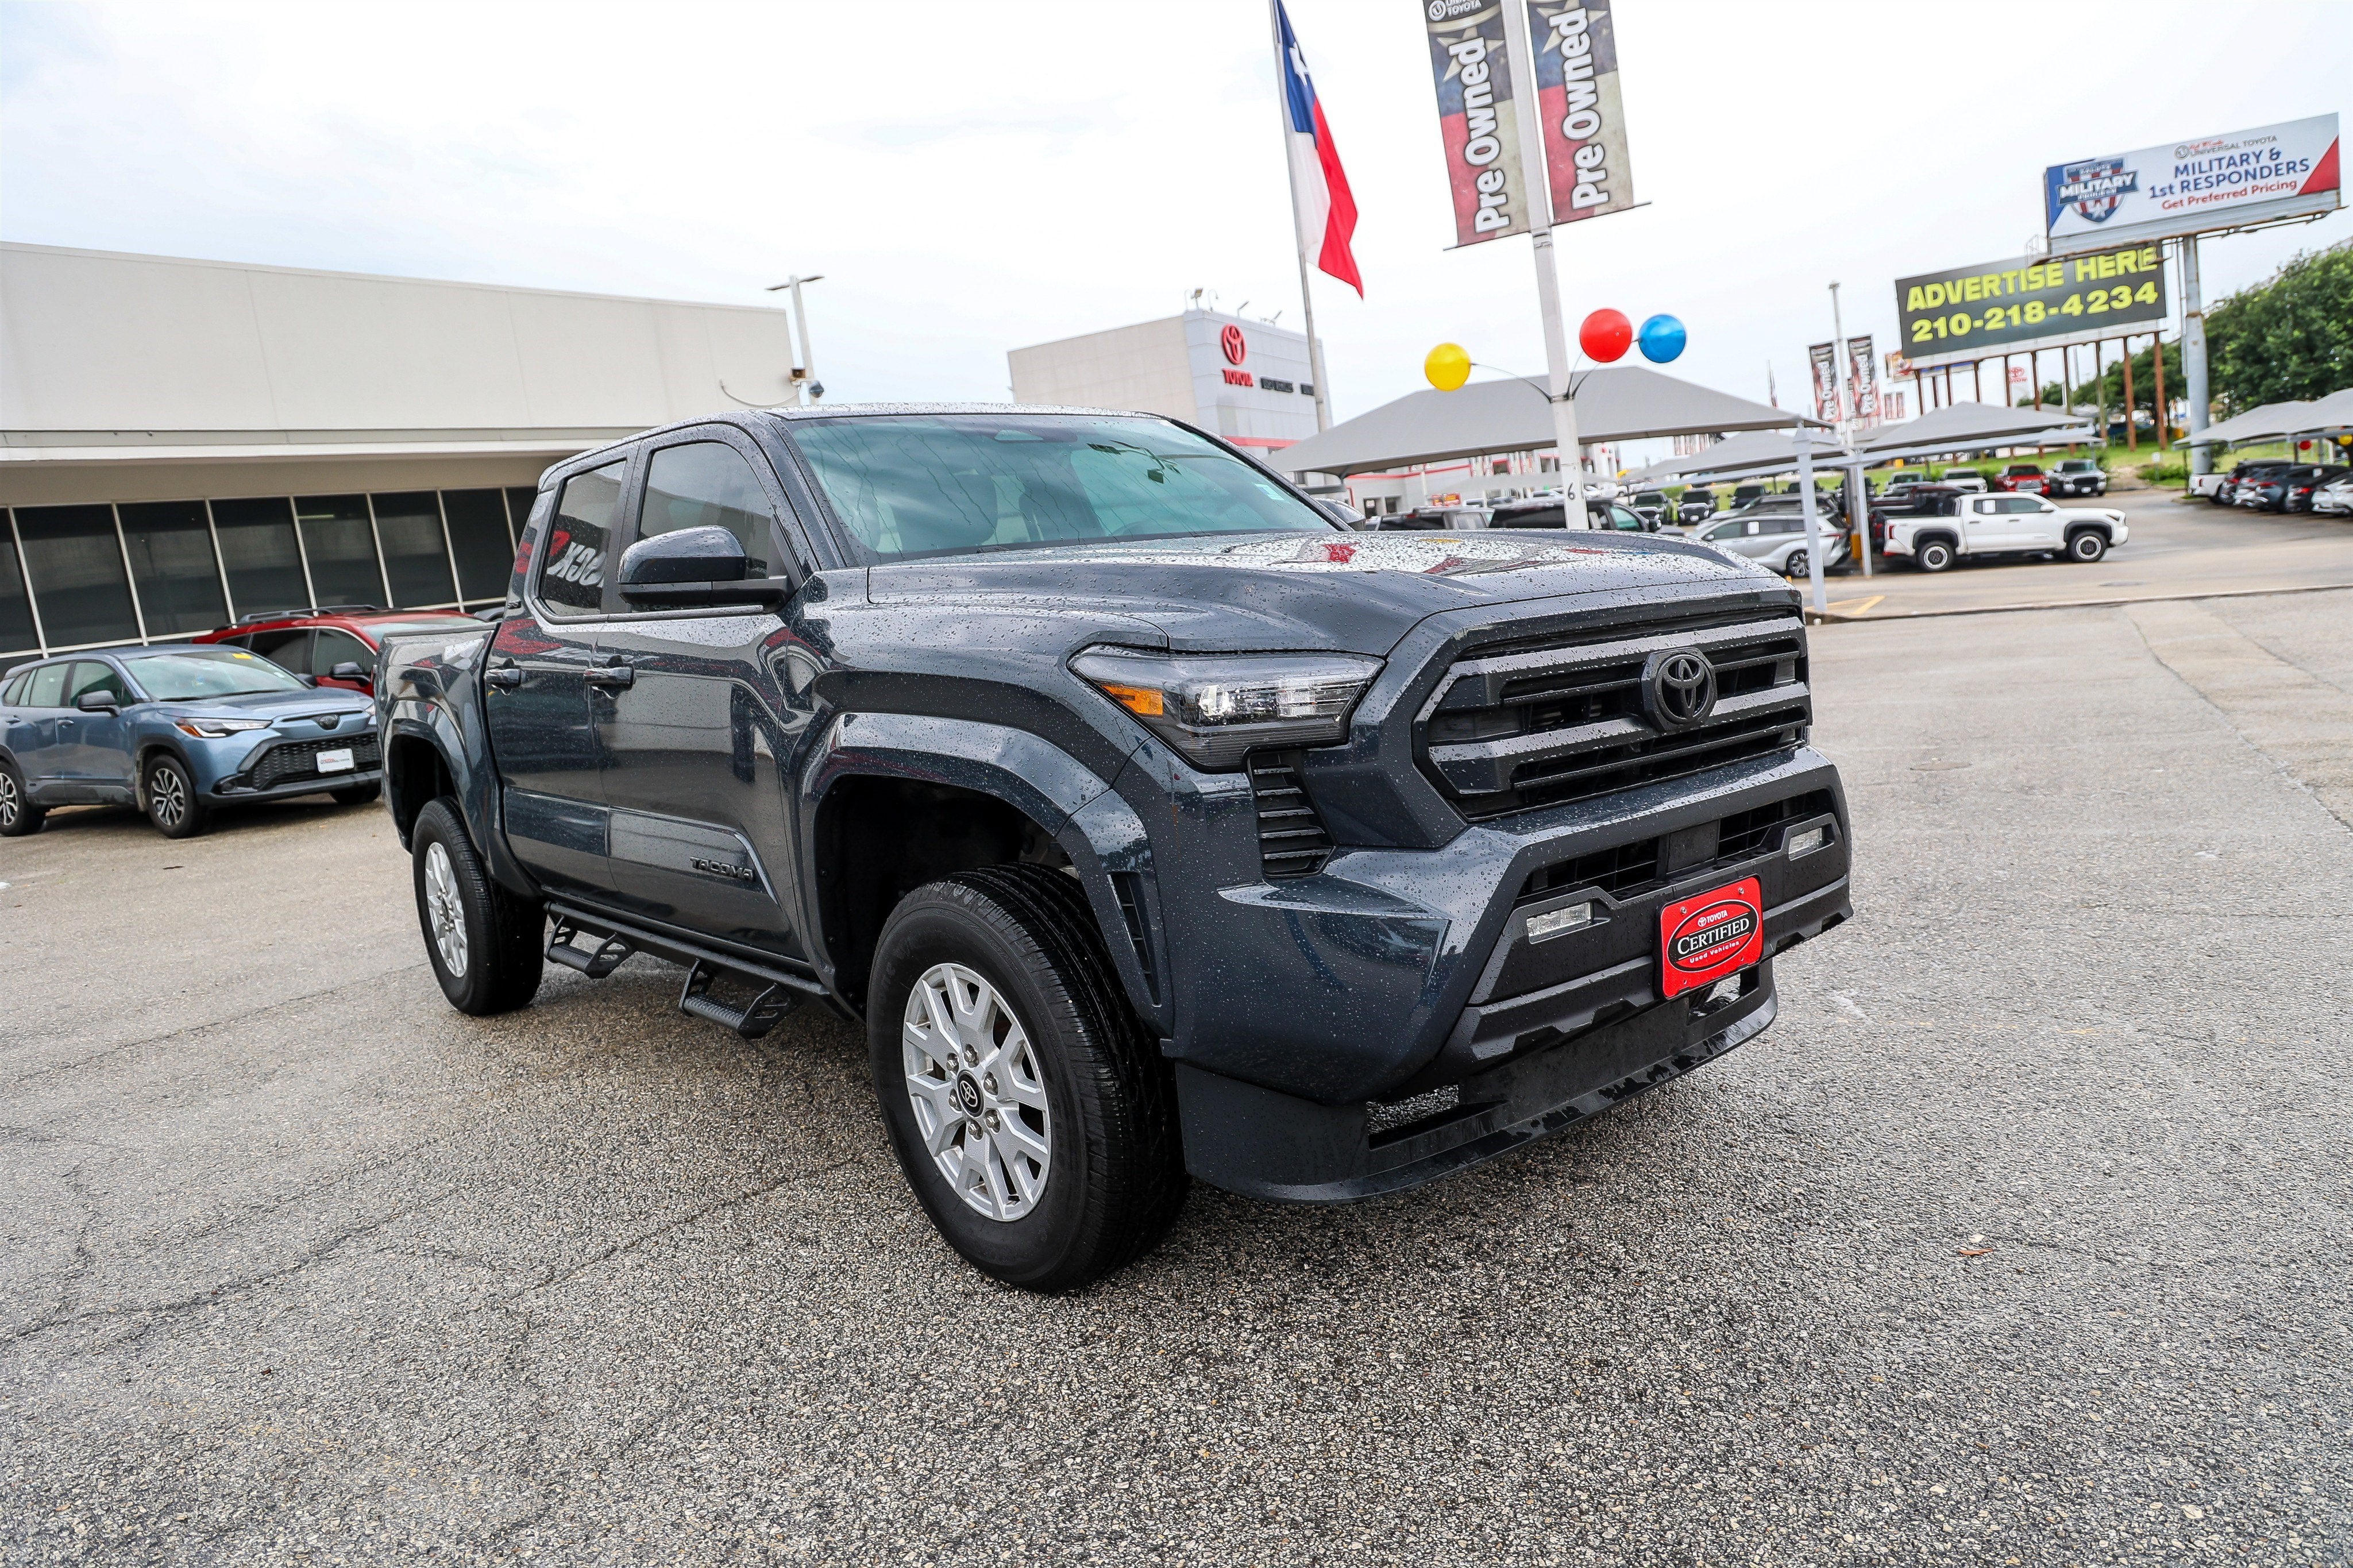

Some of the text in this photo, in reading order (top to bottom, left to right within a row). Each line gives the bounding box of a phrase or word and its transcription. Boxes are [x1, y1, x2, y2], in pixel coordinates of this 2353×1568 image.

[1447, 0, 1482, 17] TOYOTA
[1448, 36, 1500, 166] Owned
[1548, 7, 1609, 210] Pre Owned
[2243, 135, 2277, 147] TOYOTA
[2174, 146, 2282, 178] MILITARY &
[2060, 172, 2134, 199] MILITARY
[2149, 158, 2310, 199] 1st RESPONDERS
[1474, 169, 1510, 233] Pre
[2162, 179, 2298, 210] Get Preferred Pricing
[1906, 246, 2159, 312] ADVERTISE HERE
[1911, 281, 2159, 343] 210-218-4234
[1222, 367, 1254, 387] TOYOTA
[1860, 393, 1875, 415] Pre
[1568, 482, 1575, 500] 6
[689, 856, 754, 880] TACOMA
[1707, 910, 1729, 924] TOYOTA
[1677, 918, 1750, 955] CERTIFIED
[1689, 940, 1739, 963] Used Vehicles
